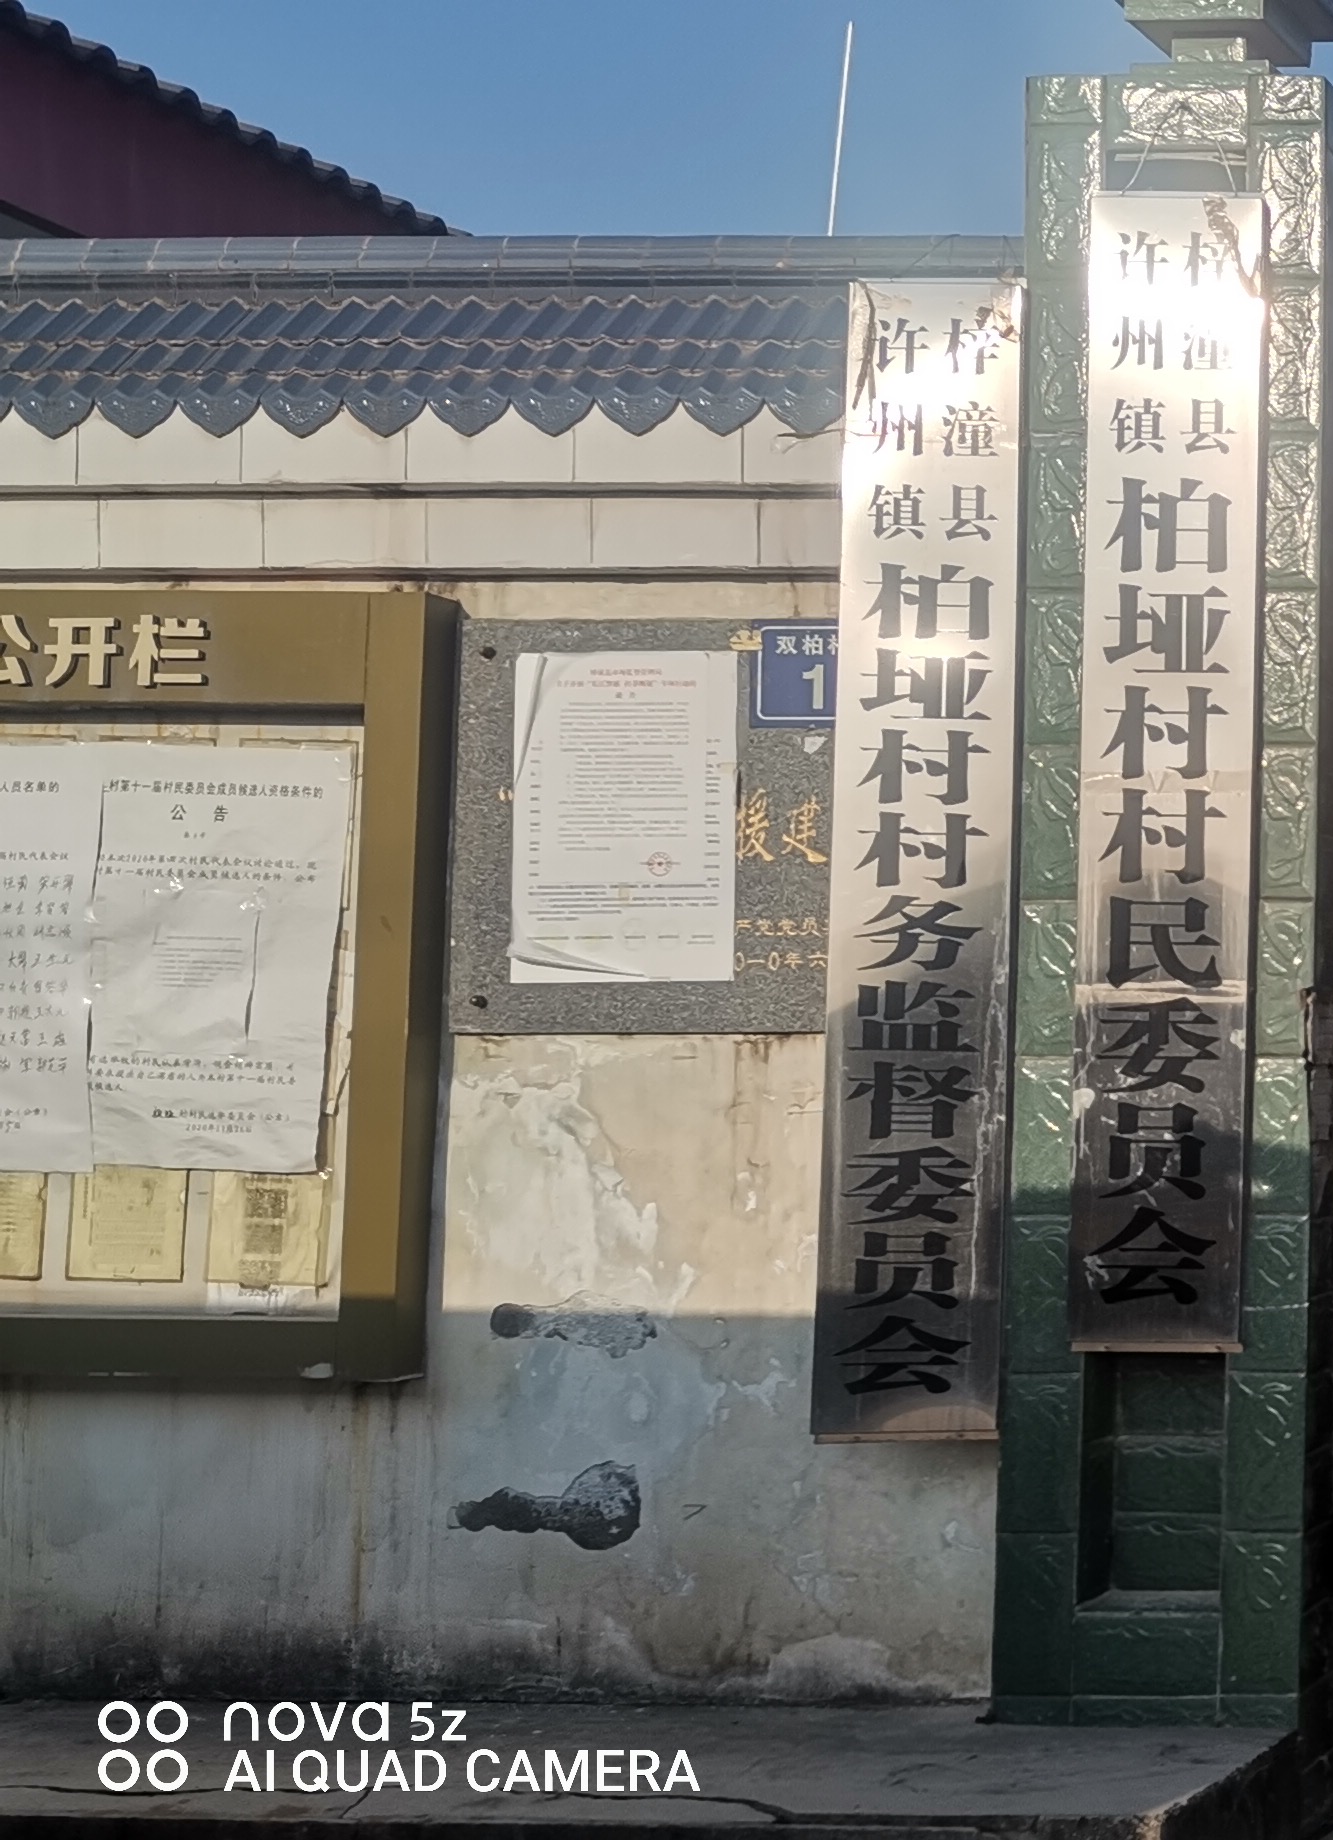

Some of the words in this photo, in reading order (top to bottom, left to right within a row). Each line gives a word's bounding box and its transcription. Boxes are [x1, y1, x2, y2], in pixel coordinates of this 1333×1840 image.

[867, 318, 929, 541] 许州镇
[941, 317, 1001, 541] 梓潼县
[1109, 231, 1169, 455] 许州镇
[1180, 231, 1238, 455] 梓潼县
[0, 614, 205, 686] 公开栏
[802, 664, 825, 710] 1
[102, 778, 324, 800] 村第十一届村民委员会成员候选人资格条件的
[1096, 476, 1234, 1307] 柏垭村村民委员会
[835, 563, 995, 1396] 柏垭村村务监督委员会
